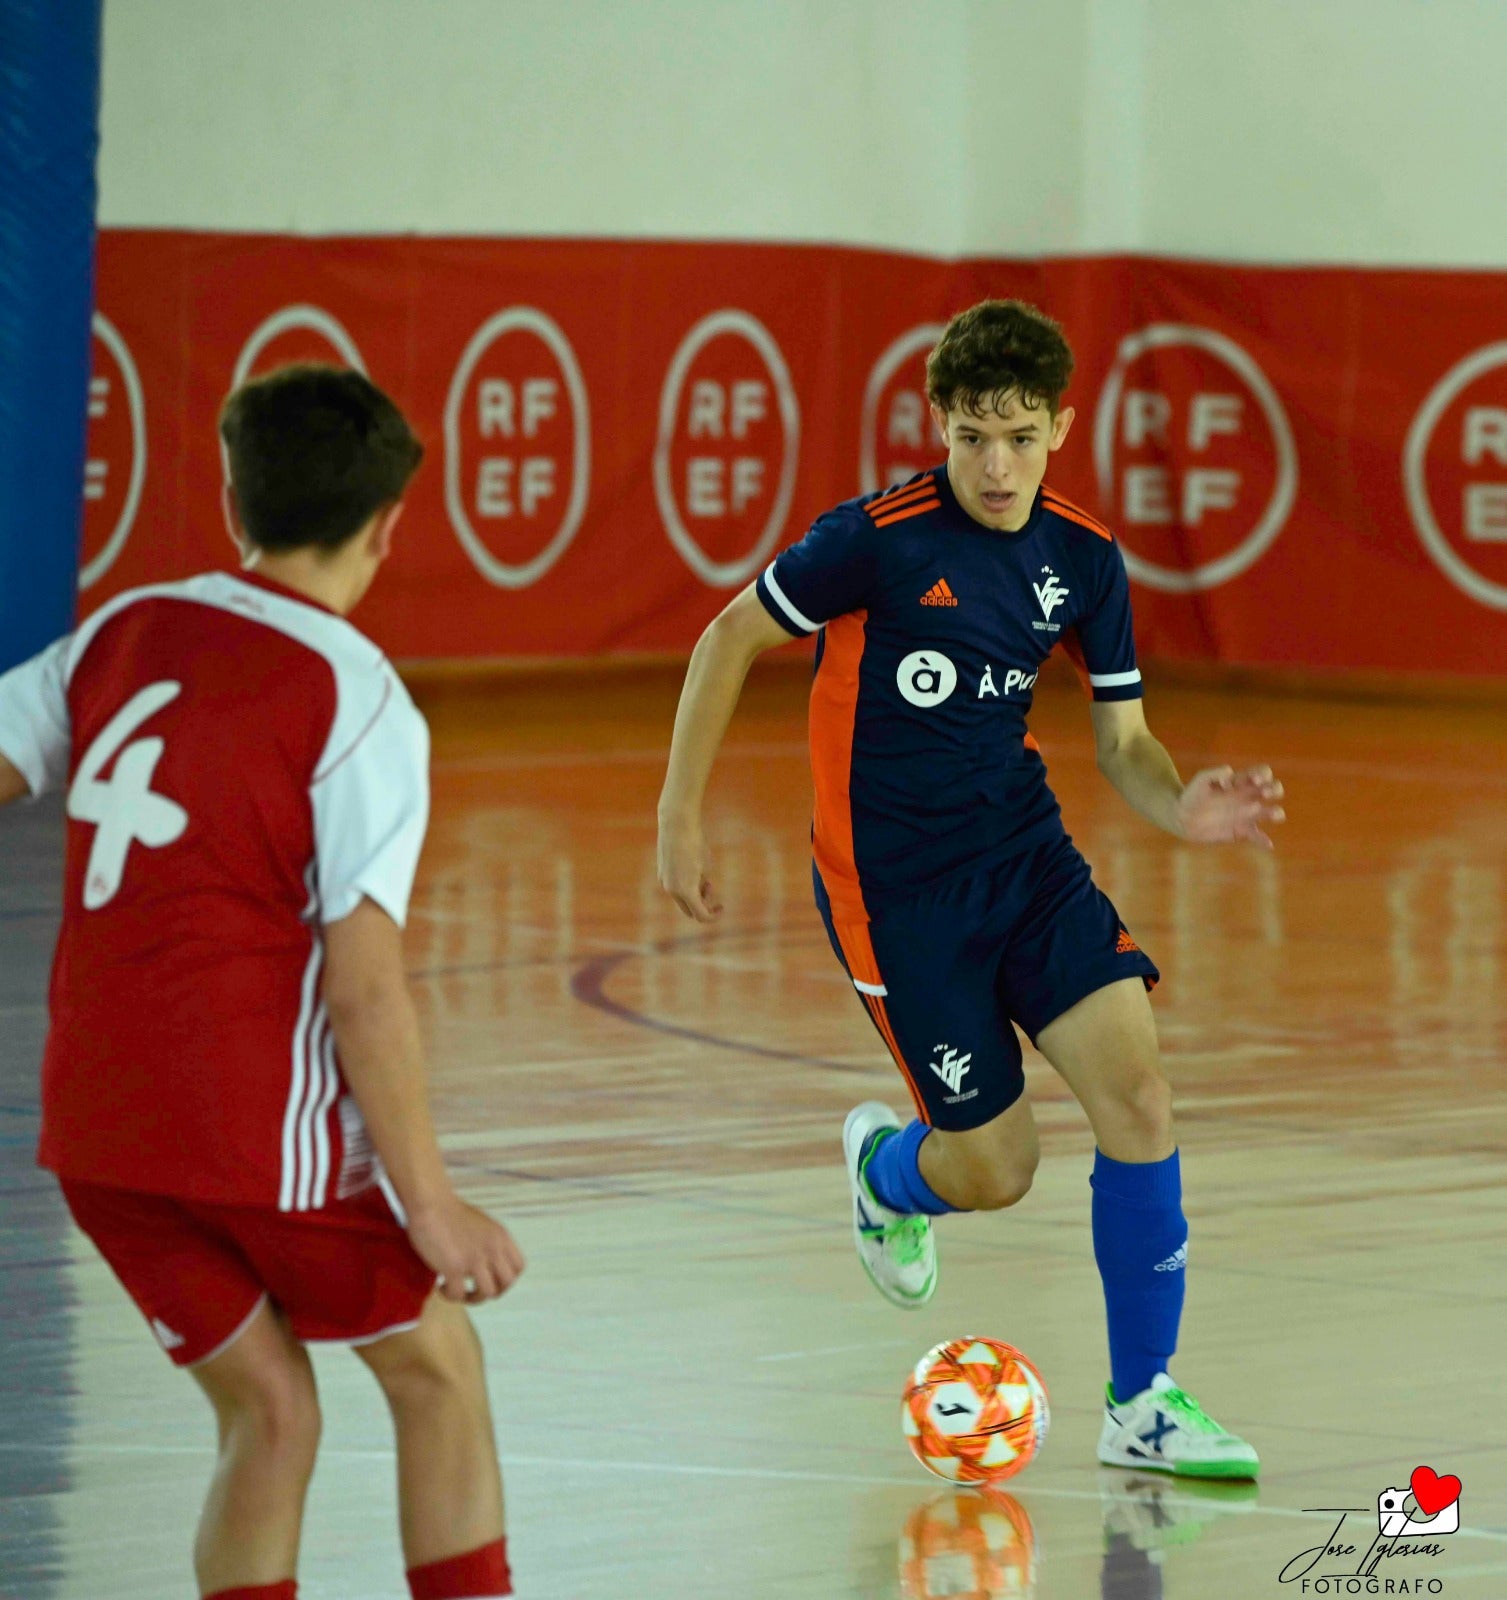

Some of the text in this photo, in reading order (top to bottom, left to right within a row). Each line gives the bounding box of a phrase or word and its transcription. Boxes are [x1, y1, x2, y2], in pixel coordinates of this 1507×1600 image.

[478, 377, 558, 438] RF
[688, 379, 768, 440] RF
[1123, 390, 1244, 452] RF
[476, 456, 557, 518] EF
[686, 456, 766, 518] EF
[1123, 466, 1241, 527] EF
[920, 596, 958, 607] adidas
[977, 664, 1000, 699] À
[67, 680, 189, 912] 4
